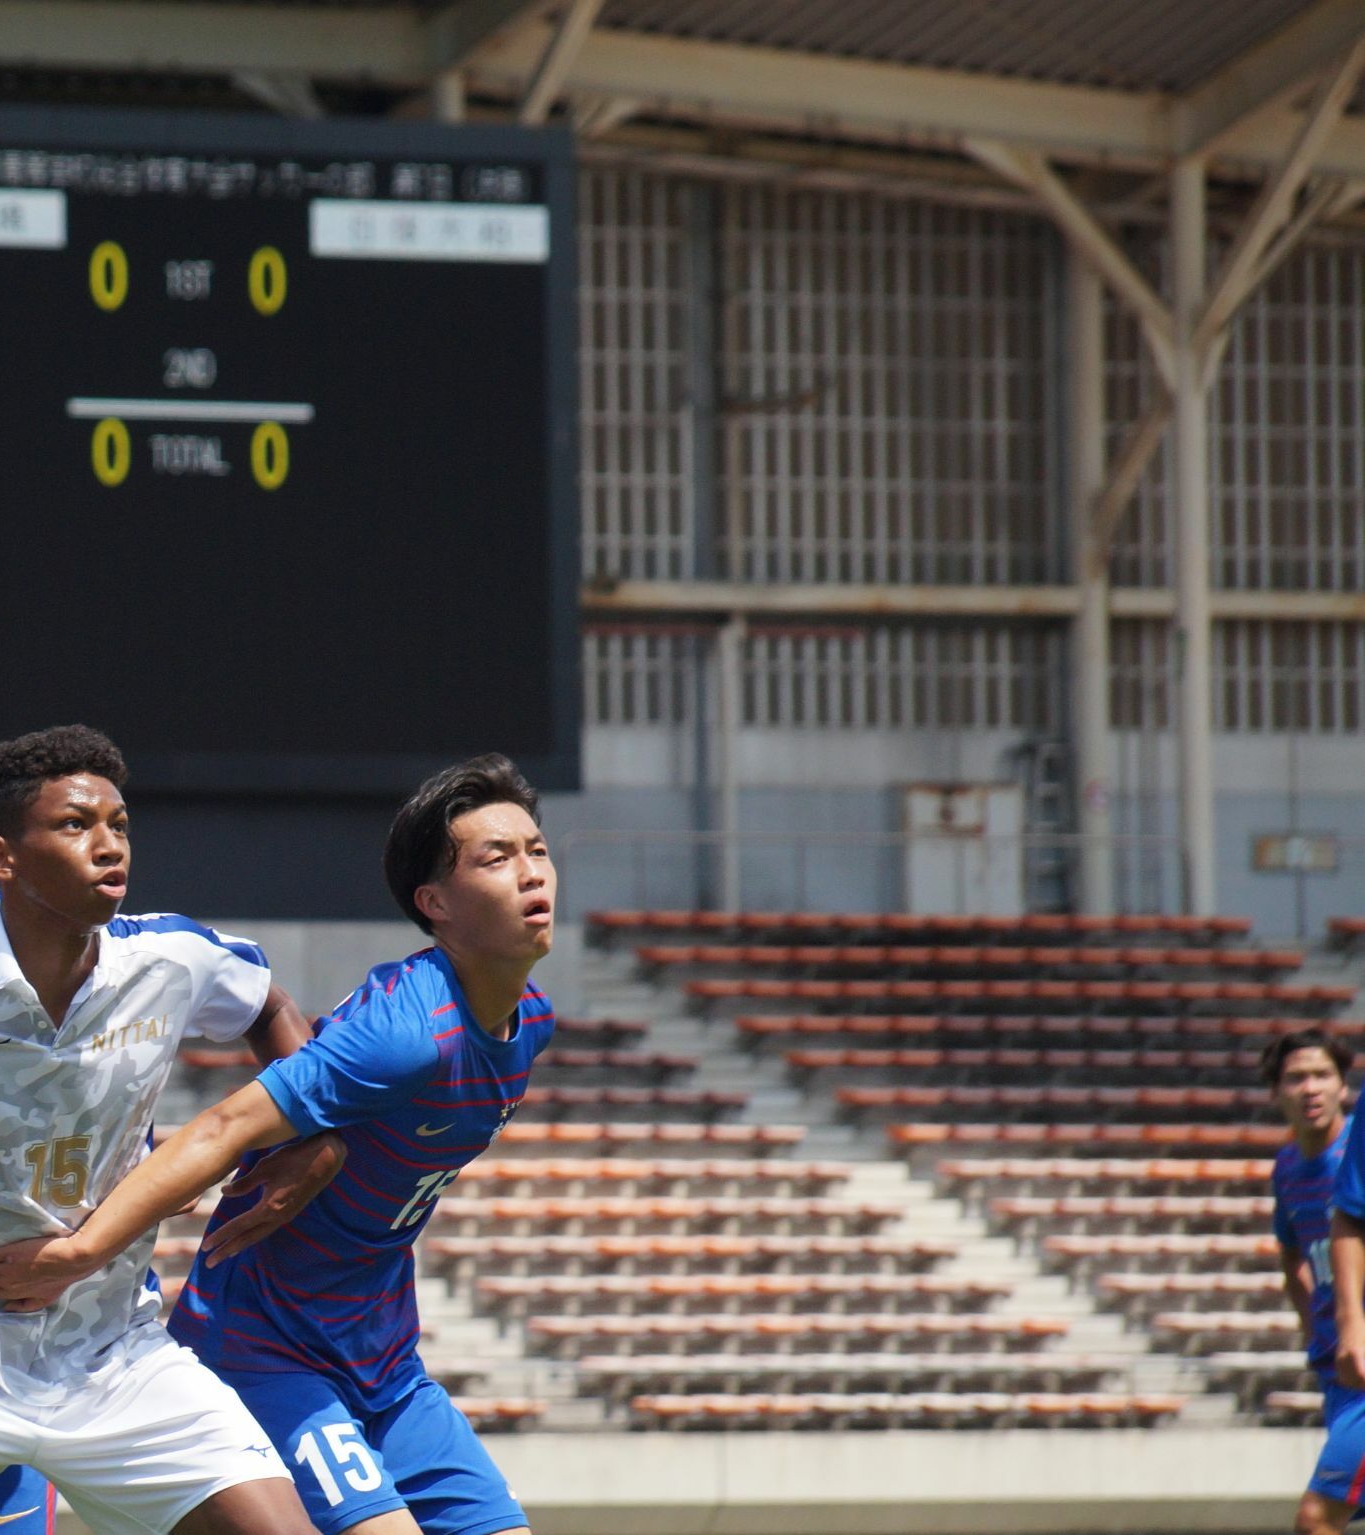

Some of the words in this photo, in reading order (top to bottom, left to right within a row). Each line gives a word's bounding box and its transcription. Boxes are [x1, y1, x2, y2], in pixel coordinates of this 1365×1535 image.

[89, 240, 129, 313] 0
[165, 259, 215, 301] 1ST
[248, 245, 287, 317] 0
[162, 347, 218, 389] 2ND
[91, 416, 131, 488] 0
[148, 433, 232, 477] TOTAL
[250, 420, 290, 492] 0
[24, 1134, 94, 1209] 15
[294, 1422, 382, 1507] 15
